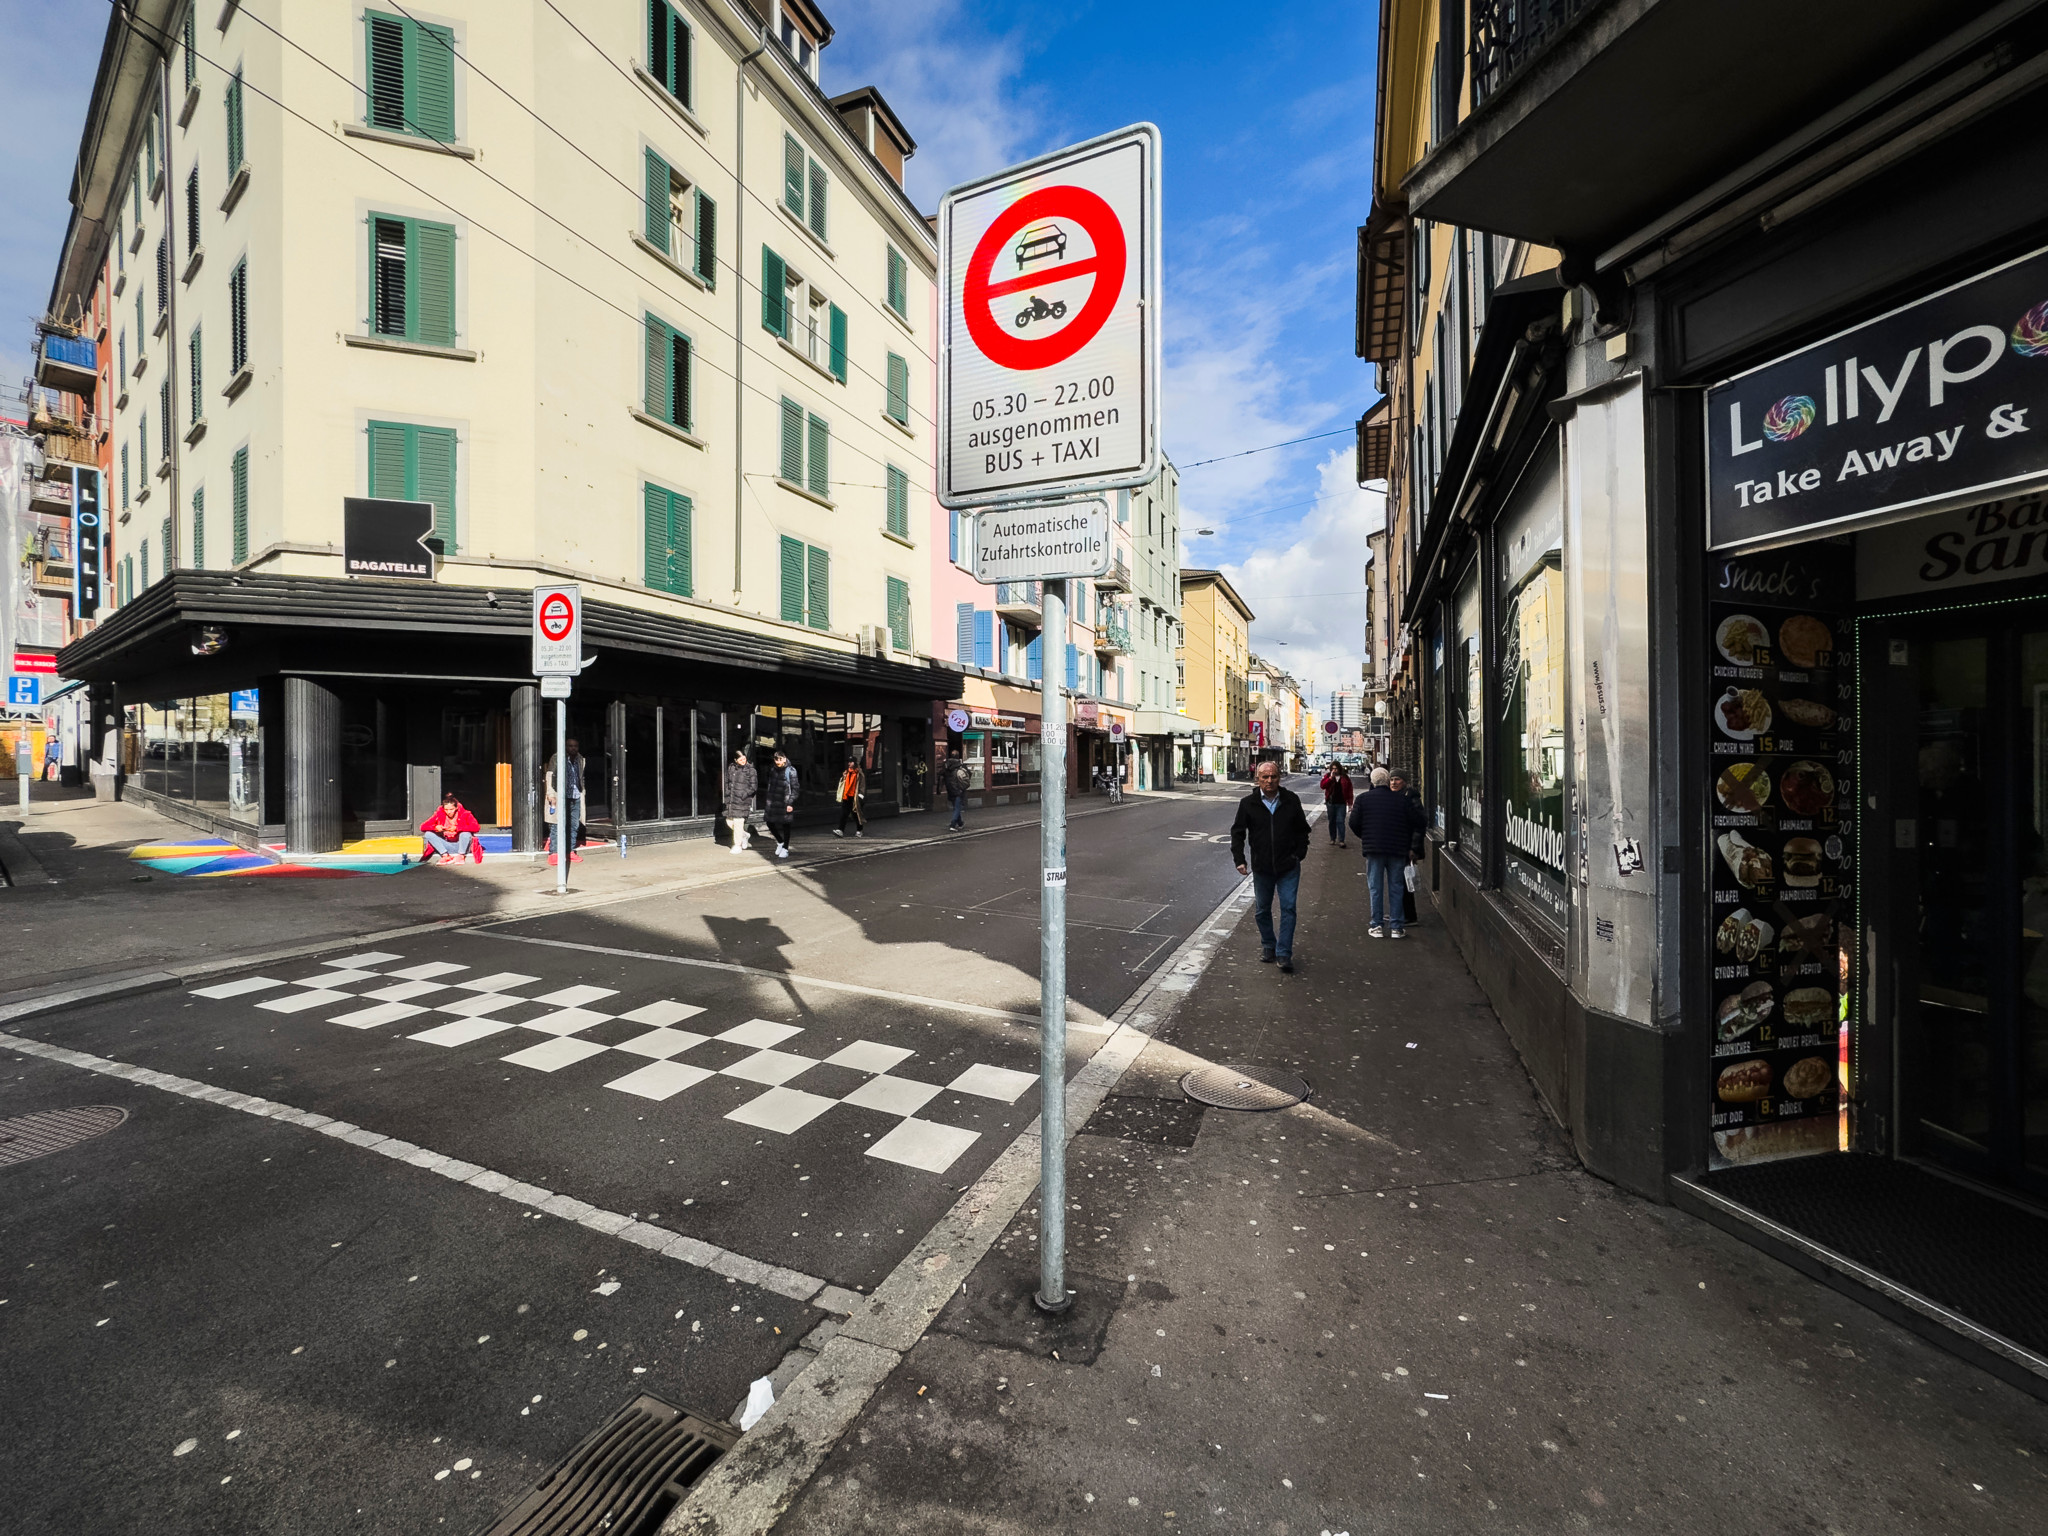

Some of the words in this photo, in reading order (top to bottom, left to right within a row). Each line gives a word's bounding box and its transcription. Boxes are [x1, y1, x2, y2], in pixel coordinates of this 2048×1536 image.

[972, 392, 1027, 421] 05.30
[1054, 375, 1115, 407] 22.00
[968, 407, 1119, 448] ausgenommen
[985, 449, 1023, 474] BUS
[1031, 451, 1045, 466] +
[1052, 436, 1100, 464] TAXI
[1734, 468, 1821, 508] Take
[1836, 425, 1965, 483] Away
[1985, 403, 2031, 438] &
[1968, 493, 2048, 537] Bä
[993, 515, 1088, 538] Automatische
[981, 536, 1101, 562] Zufahrtskontrolle
[350, 560, 426, 574] BAGATELLE
[1714, 665, 1737, 678] CHICKEN
[17, 678, 32, 692] P
[1714, 742, 1738, 754] CHICKEN
[1779, 739, 1794, 751] PIDE
[1714, 889, 1739, 904] FALAFEL
[1714, 966, 1735, 980] GYROS
[1736, 964, 1749, 978] PITA
[1729, 1110, 1743, 1123] DOG
